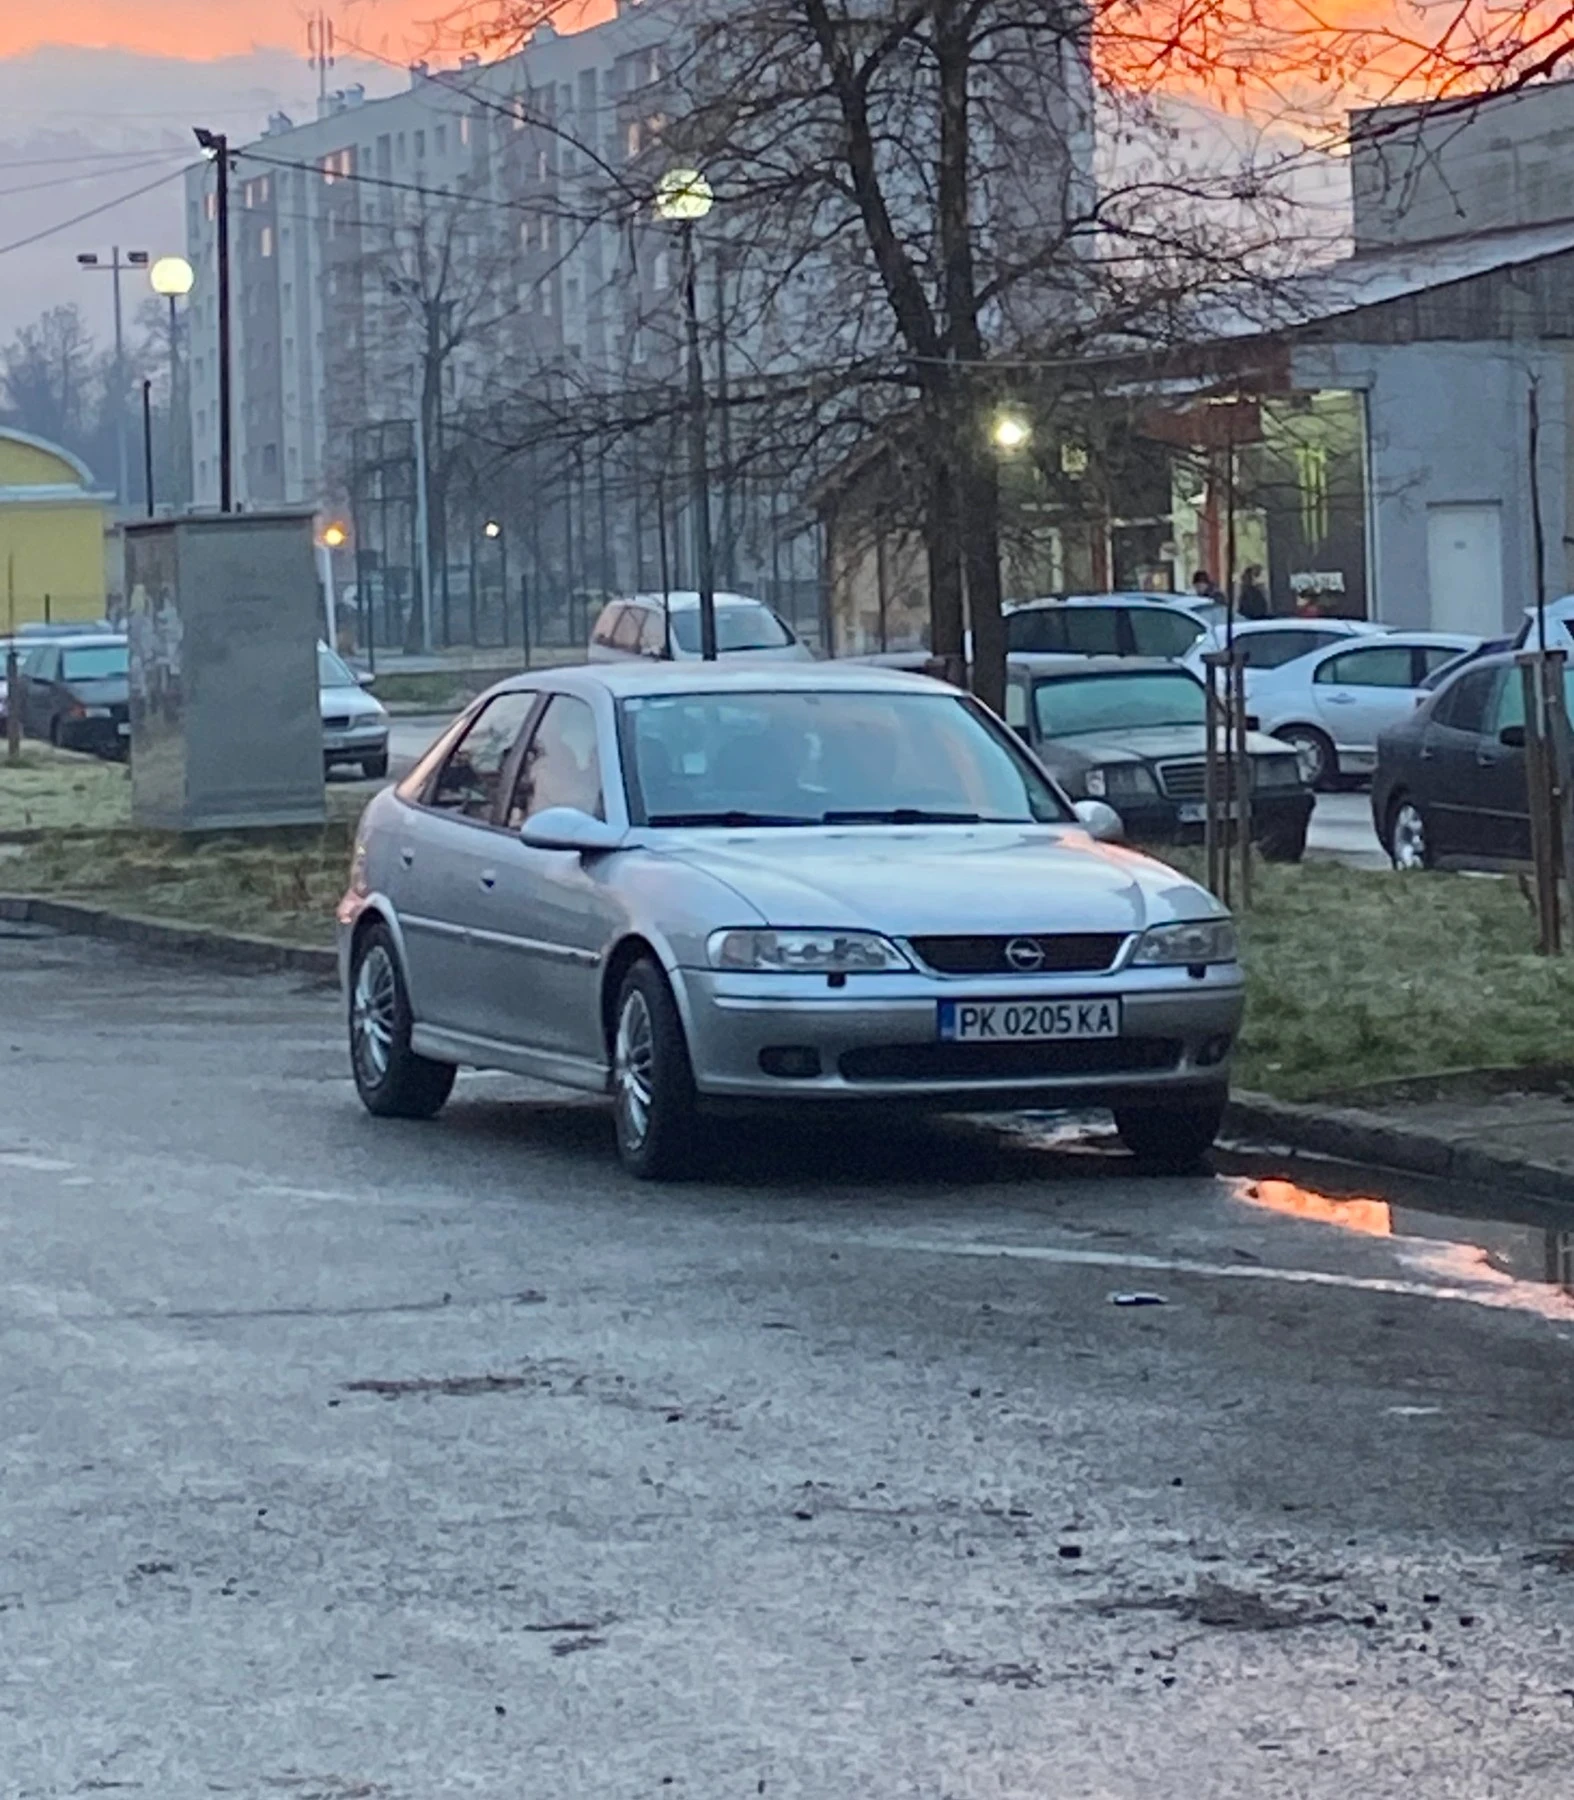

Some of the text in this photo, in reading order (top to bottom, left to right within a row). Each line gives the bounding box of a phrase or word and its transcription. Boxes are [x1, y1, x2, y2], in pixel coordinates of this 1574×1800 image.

[960, 1004, 1113, 1037] PK 0205 KA
